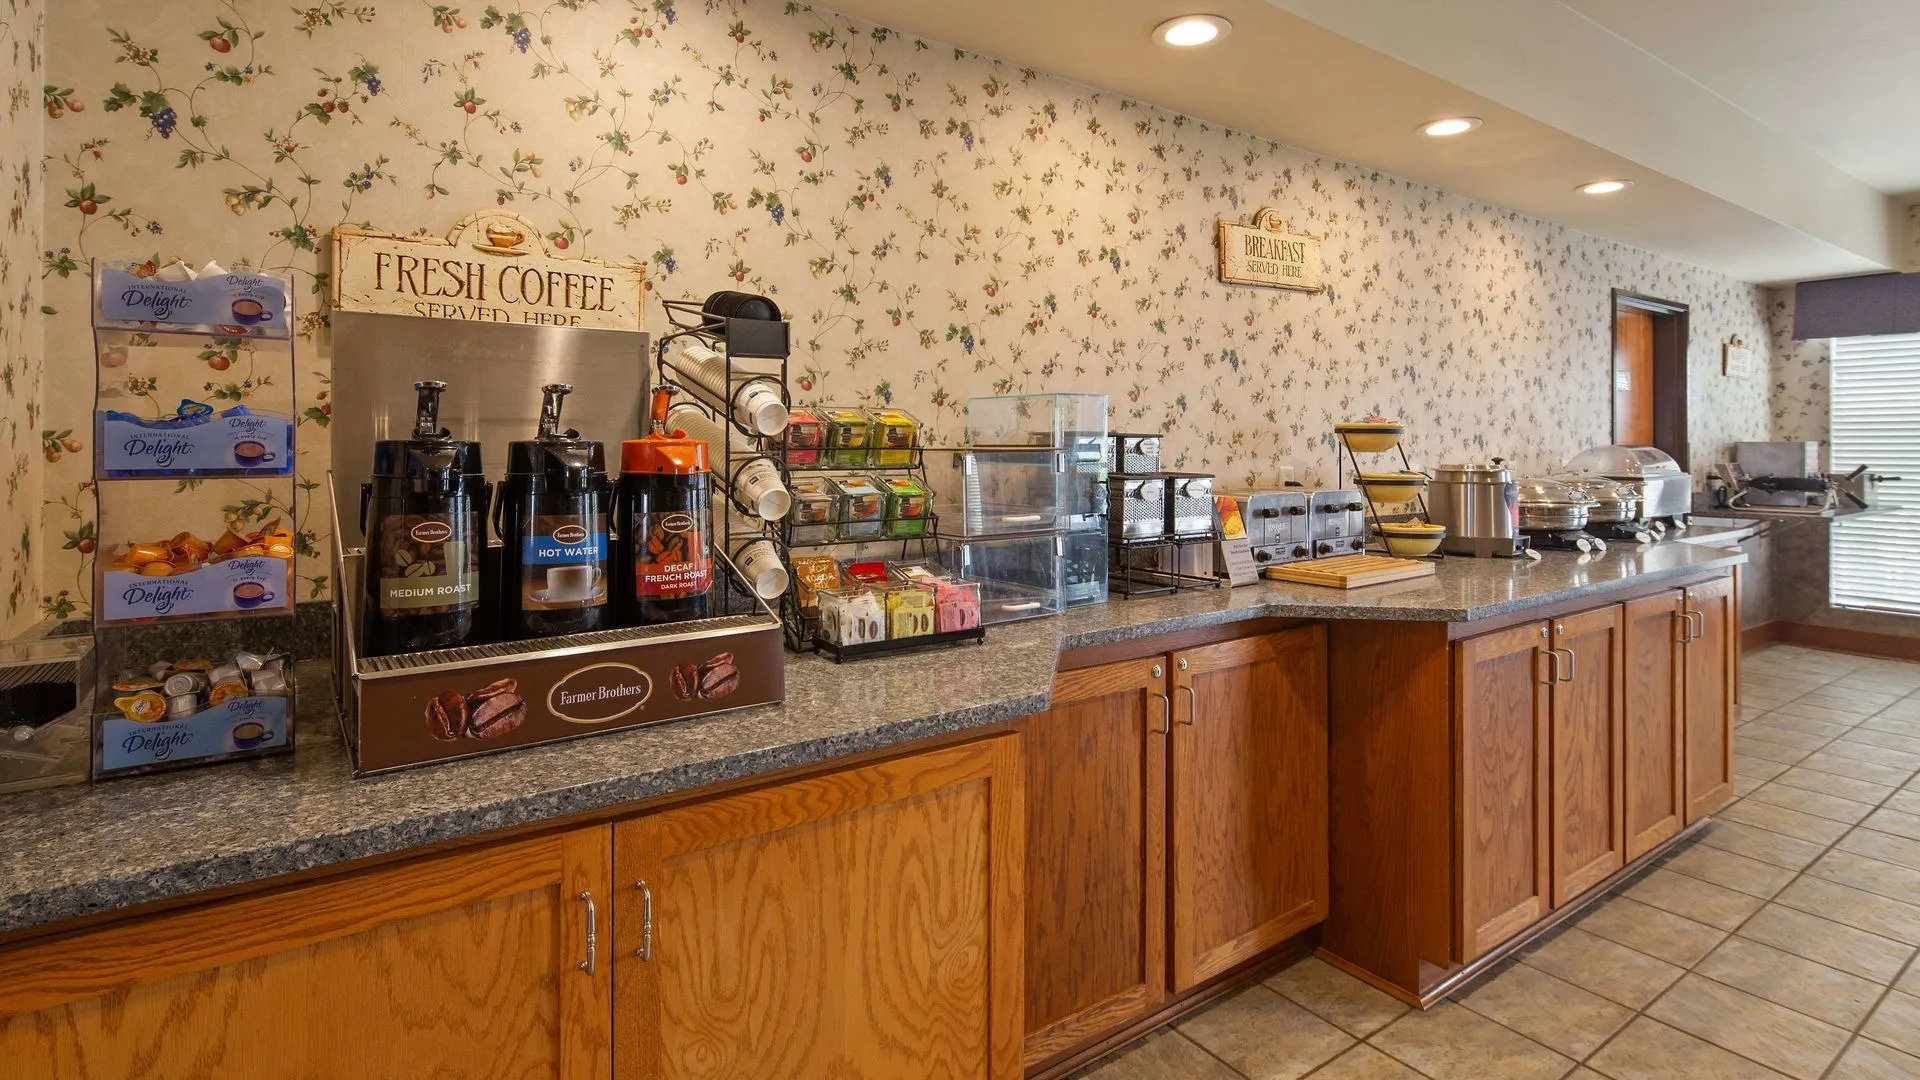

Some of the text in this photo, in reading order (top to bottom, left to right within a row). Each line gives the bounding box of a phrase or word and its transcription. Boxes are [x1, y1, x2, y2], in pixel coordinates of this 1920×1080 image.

[1244, 234, 1306, 264] BREAKFAST
[1246, 259, 1302, 279] SERVED HERE
[127, 284, 187, 294] INTERNATIONAL
[226, 275, 264, 293] Delight
[373, 251, 617, 312] FRESH COFFEE
[121, 289, 193, 320] Delight
[229, 418, 267, 435] Delight
[130, 432, 190, 440] INTERNATIONAL
[123, 438, 195, 468] Delight
[538, 546, 599, 558] HOT WATER
[228, 559, 267, 576] Delight
[645, 569, 708, 583] FRENCH ROAST
[664, 562, 694, 573] DECAF
[129, 579, 189, 588] INTERNATIONAL
[390, 583, 472, 598] MEDIUM ROAST
[678, 580, 697, 588] ROAST
[122, 586, 195, 615] Delight
[560, 683, 642, 706] Farmer Brothers
[128, 724, 189, 737] INTERNATIONAL
[122, 731, 194, 761] Delight
